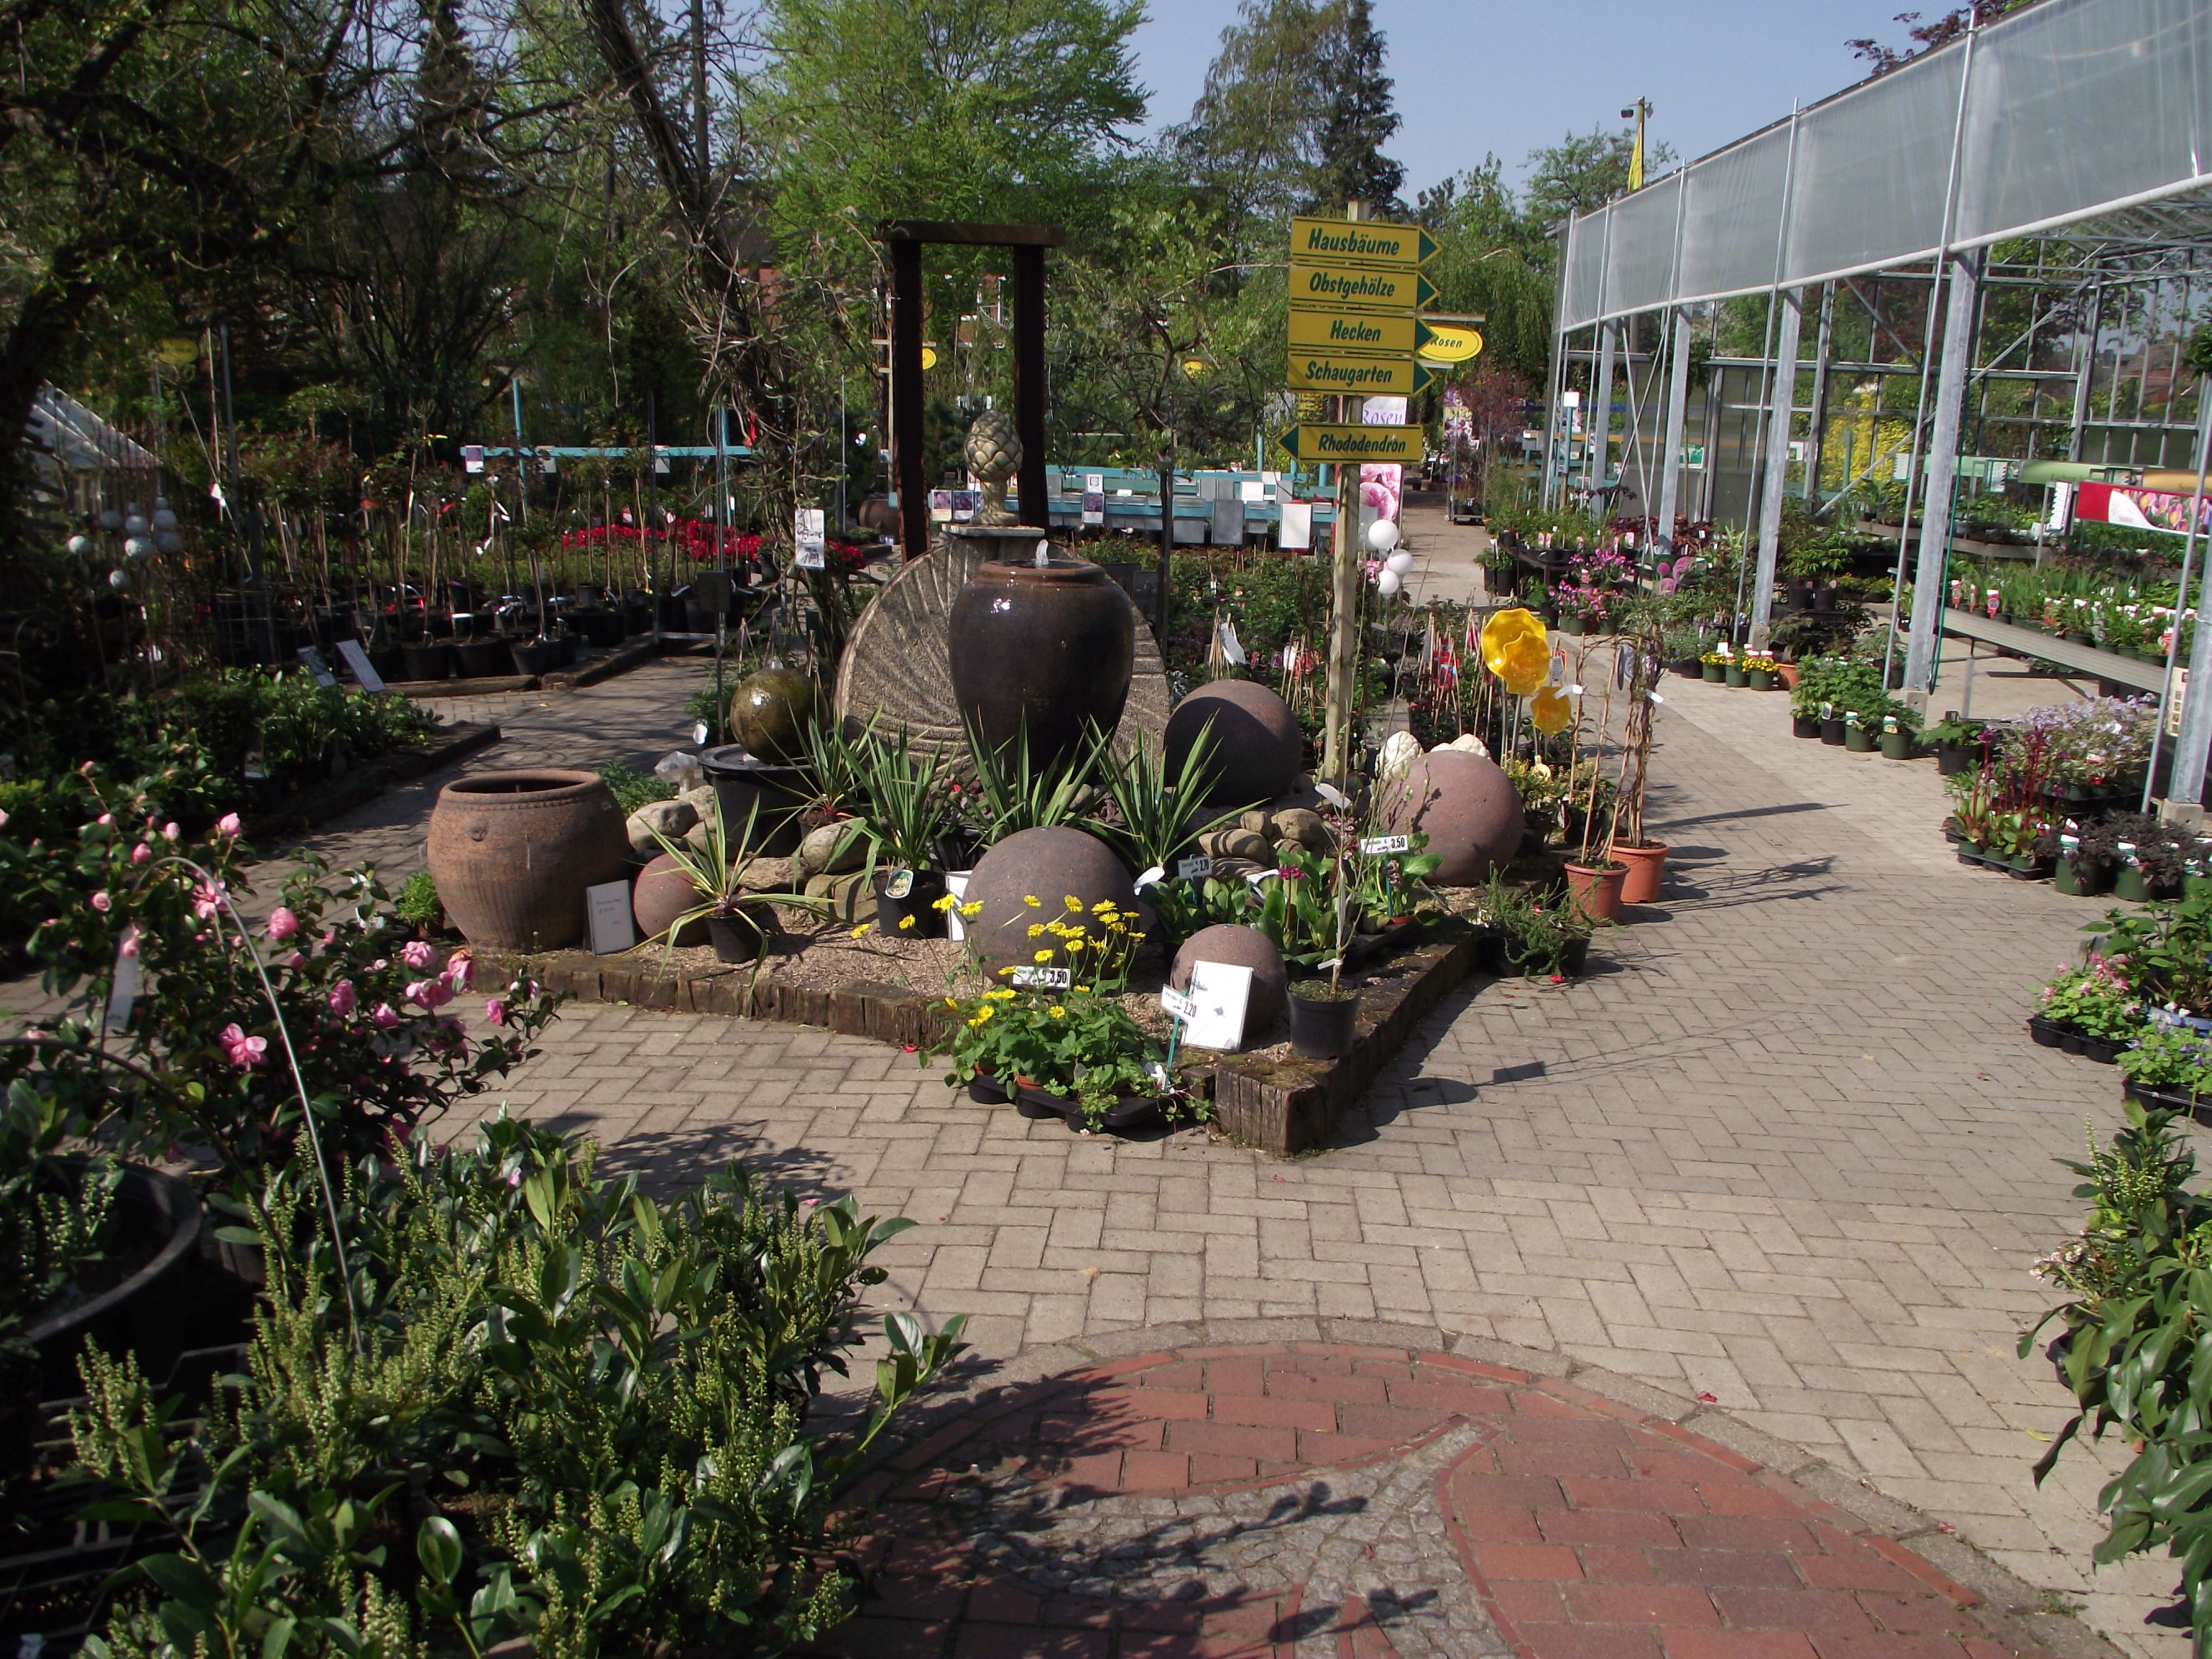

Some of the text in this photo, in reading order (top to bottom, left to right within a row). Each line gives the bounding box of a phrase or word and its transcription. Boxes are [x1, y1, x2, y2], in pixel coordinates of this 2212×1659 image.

[1308, 227, 1400, 255] Hausbäume
[1309, 272, 1395, 299] Obstgehölze
[1329, 319, 1382, 342] Hecken
[1429, 337, 1463, 348] Rosen
[1305, 360, 1393, 387] Schaugarten
[1363, 408, 1404, 425] Rosen
[1318, 433, 1406, 452] Rhododendron
